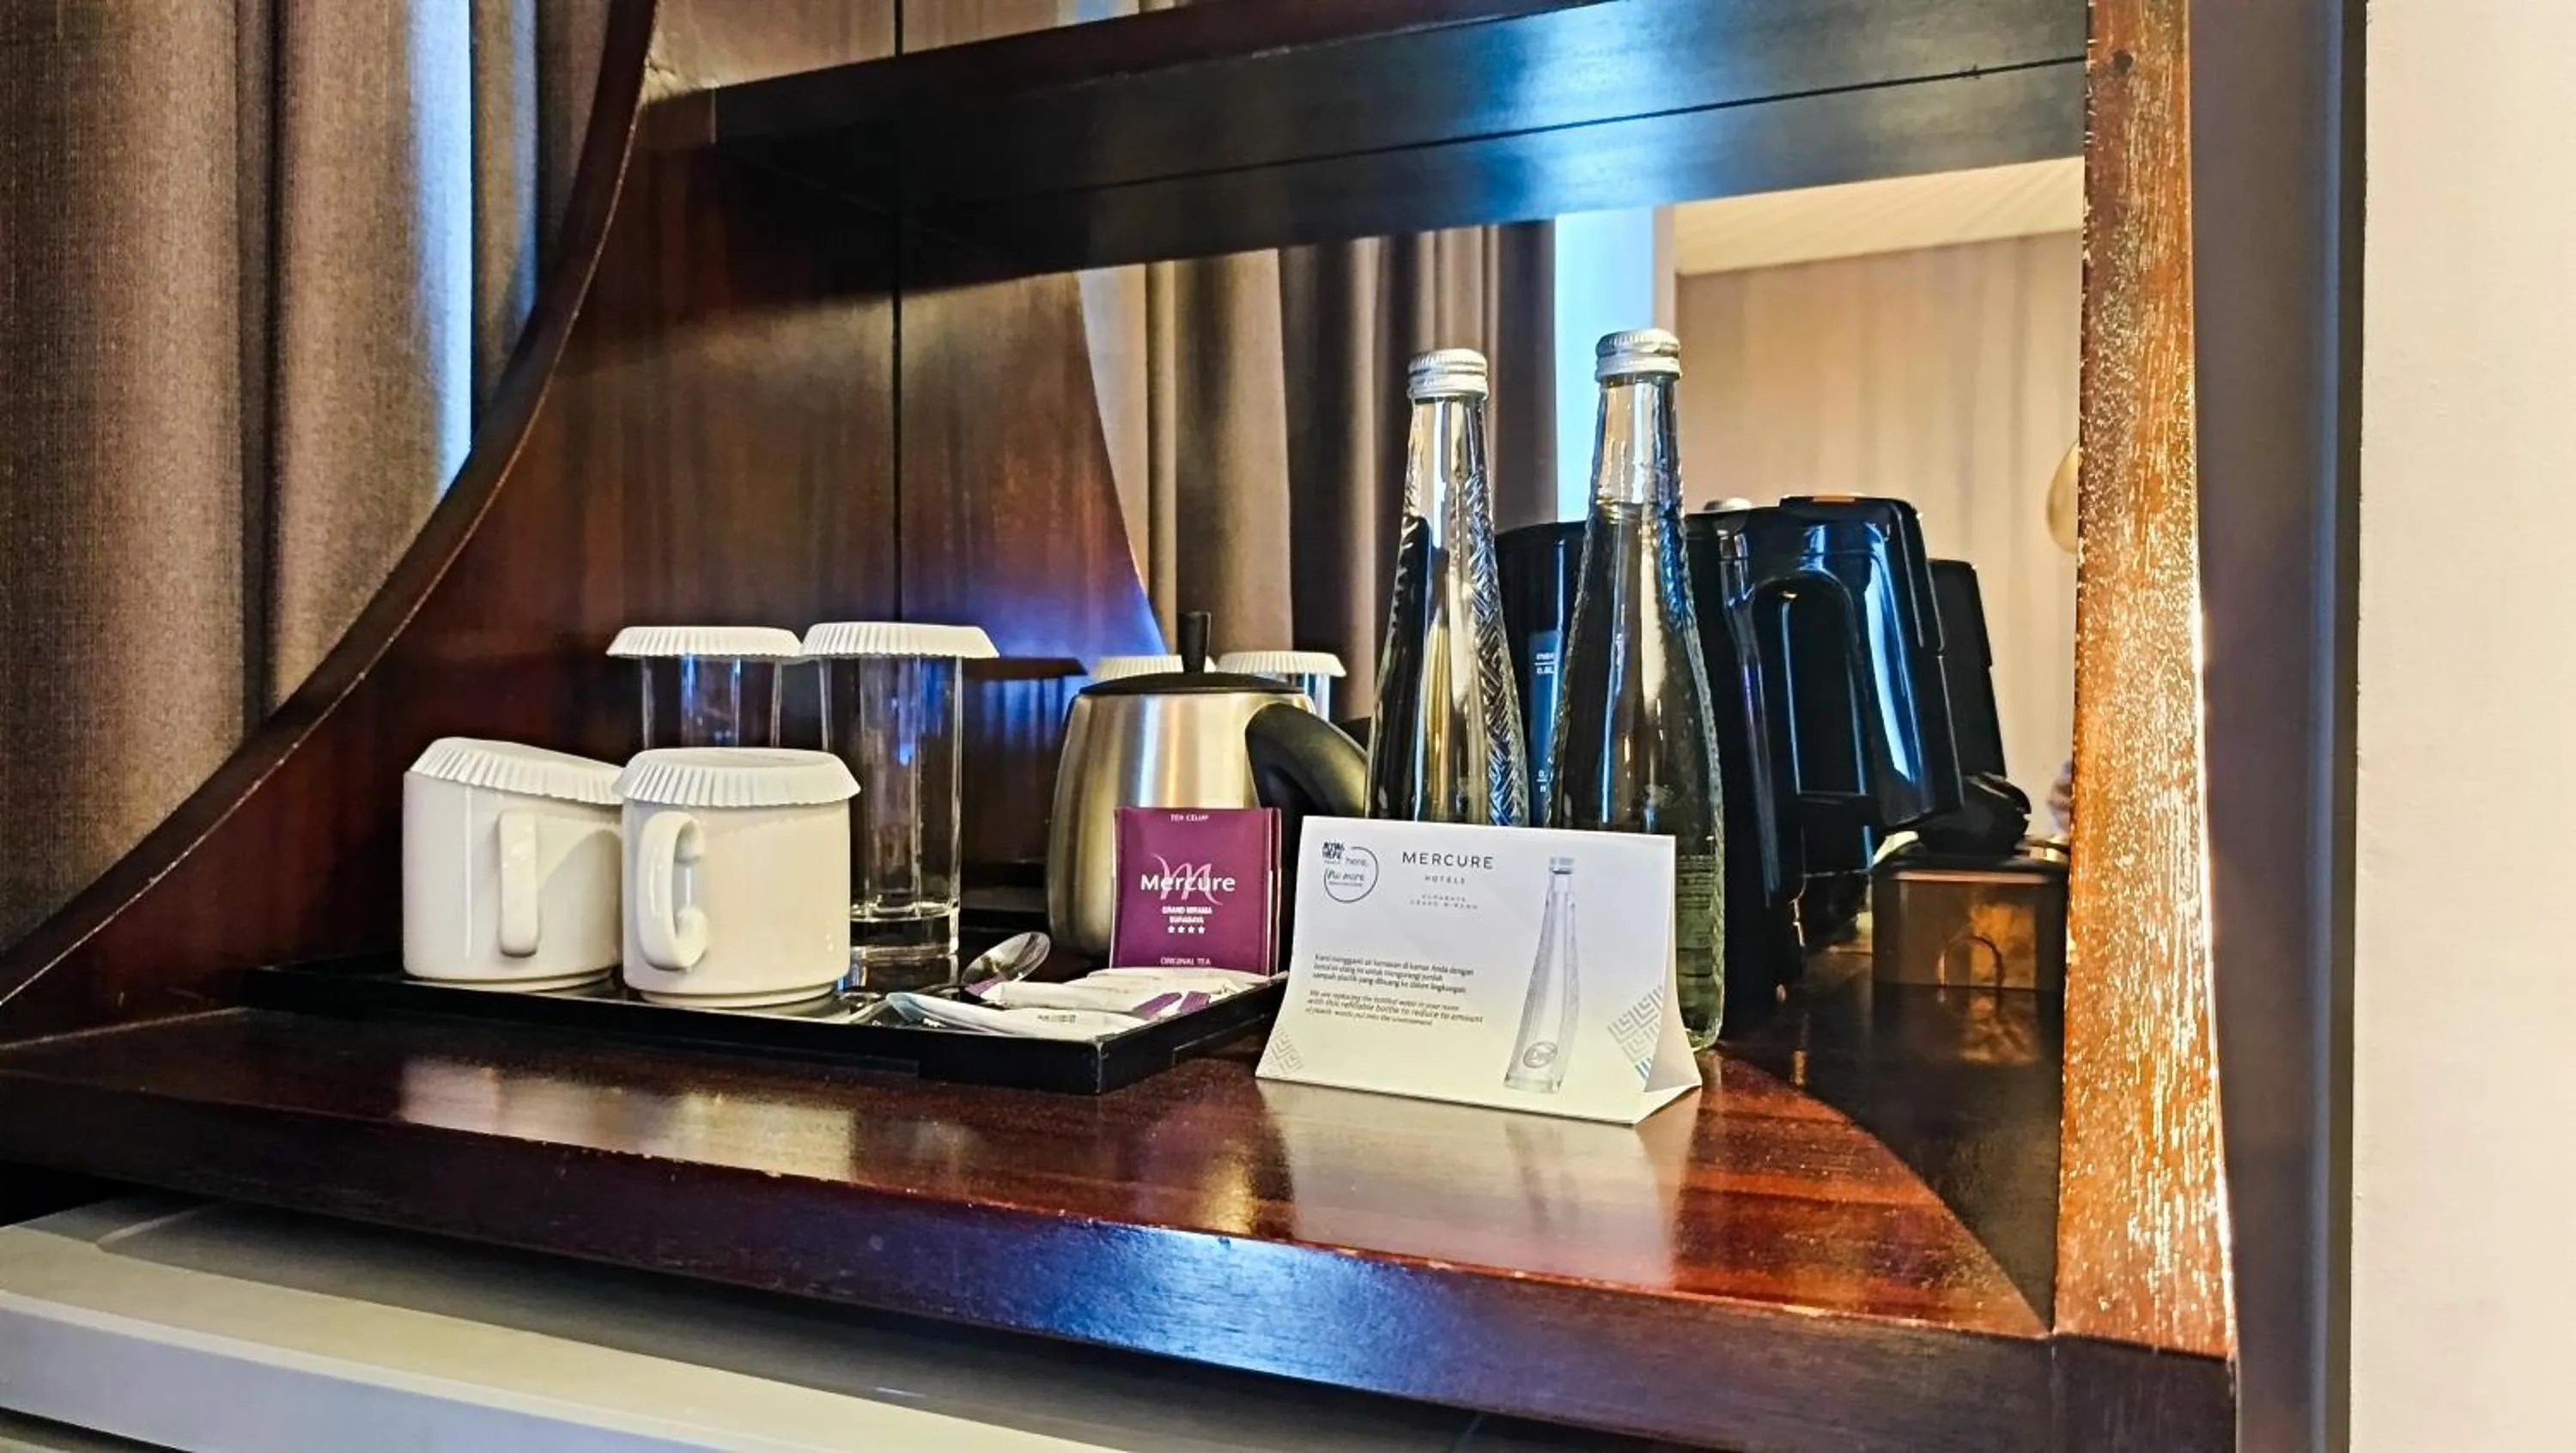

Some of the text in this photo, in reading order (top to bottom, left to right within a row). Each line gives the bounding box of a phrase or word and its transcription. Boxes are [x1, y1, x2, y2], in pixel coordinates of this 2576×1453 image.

[1402, 851, 1494, 870] MERCURE
[1139, 873, 1236, 891] Mercure
[1425, 875, 1467, 885] HOTELS
[1160, 956, 1212, 966] ORIGINAL TEA
